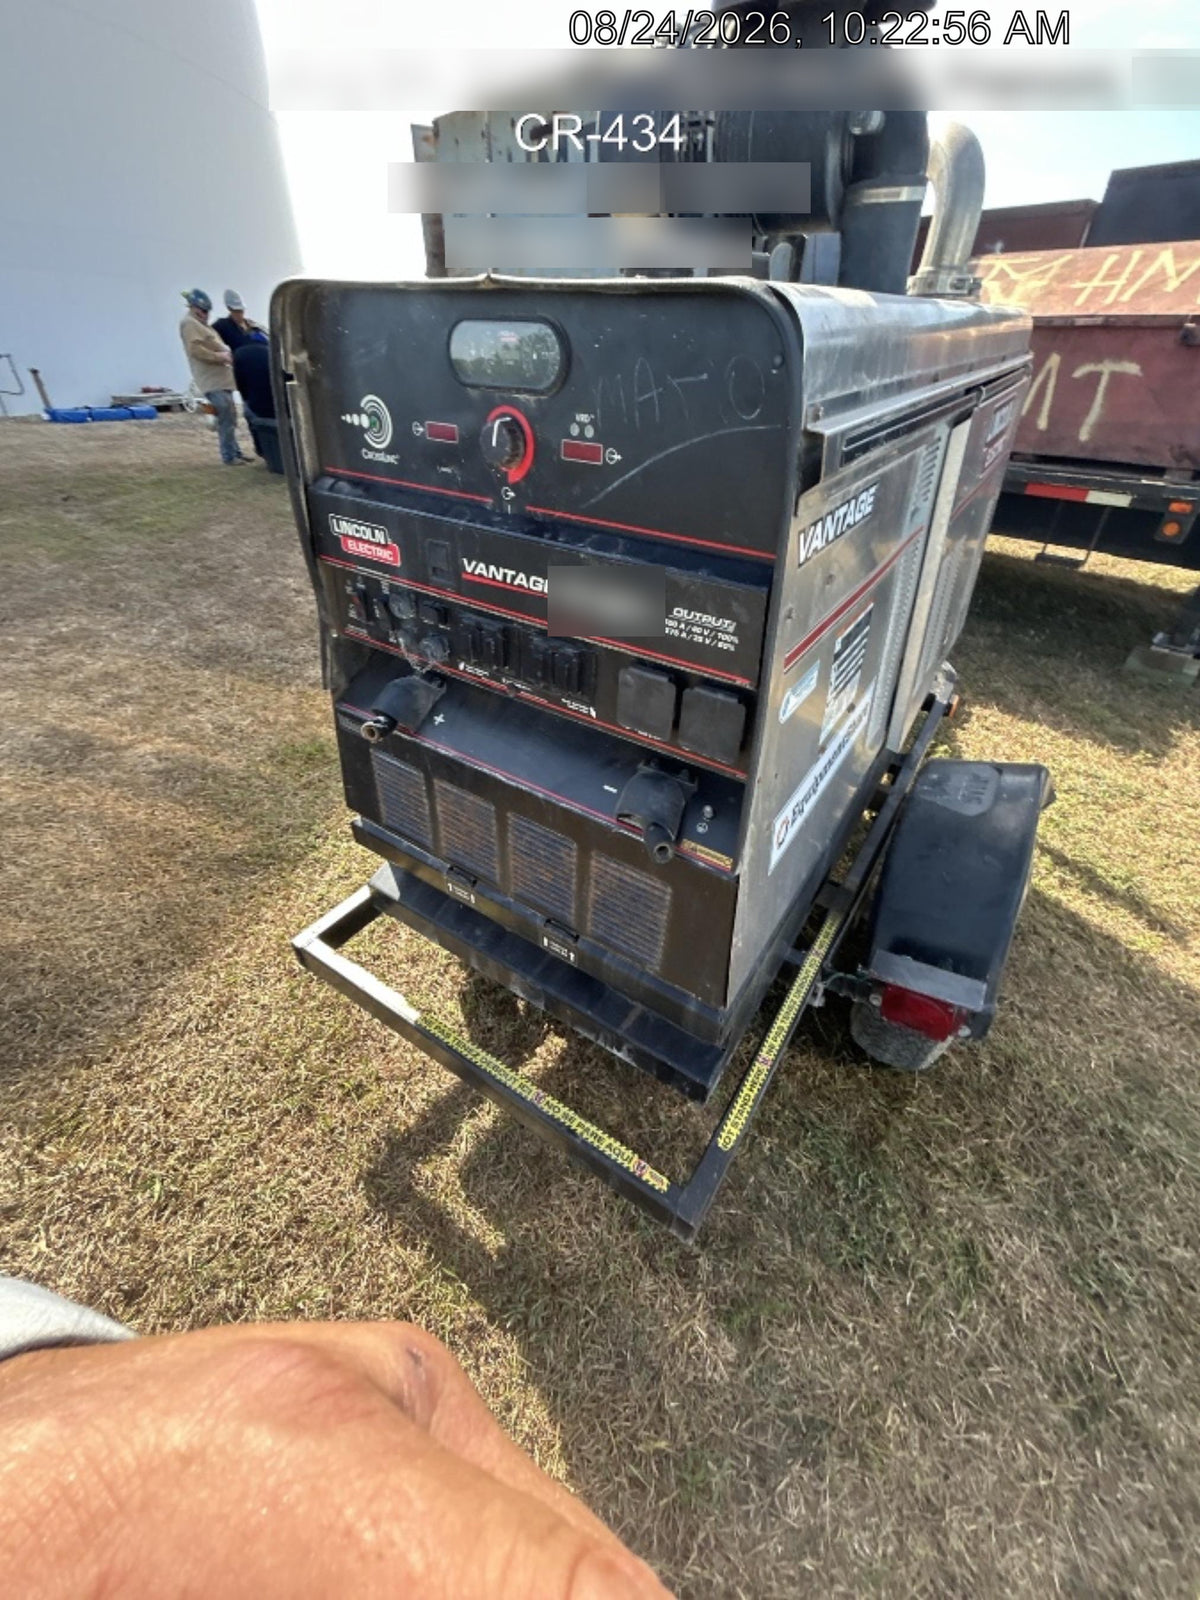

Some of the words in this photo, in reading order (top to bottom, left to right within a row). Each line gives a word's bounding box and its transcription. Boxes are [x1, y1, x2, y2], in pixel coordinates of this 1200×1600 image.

[332, 518, 386, 545] LINCOLN
[799, 484, 878, 565] VANTAGE
[347, 539, 394, 561] ELECTRIC
[674, 607, 734, 632] OUTPUT
